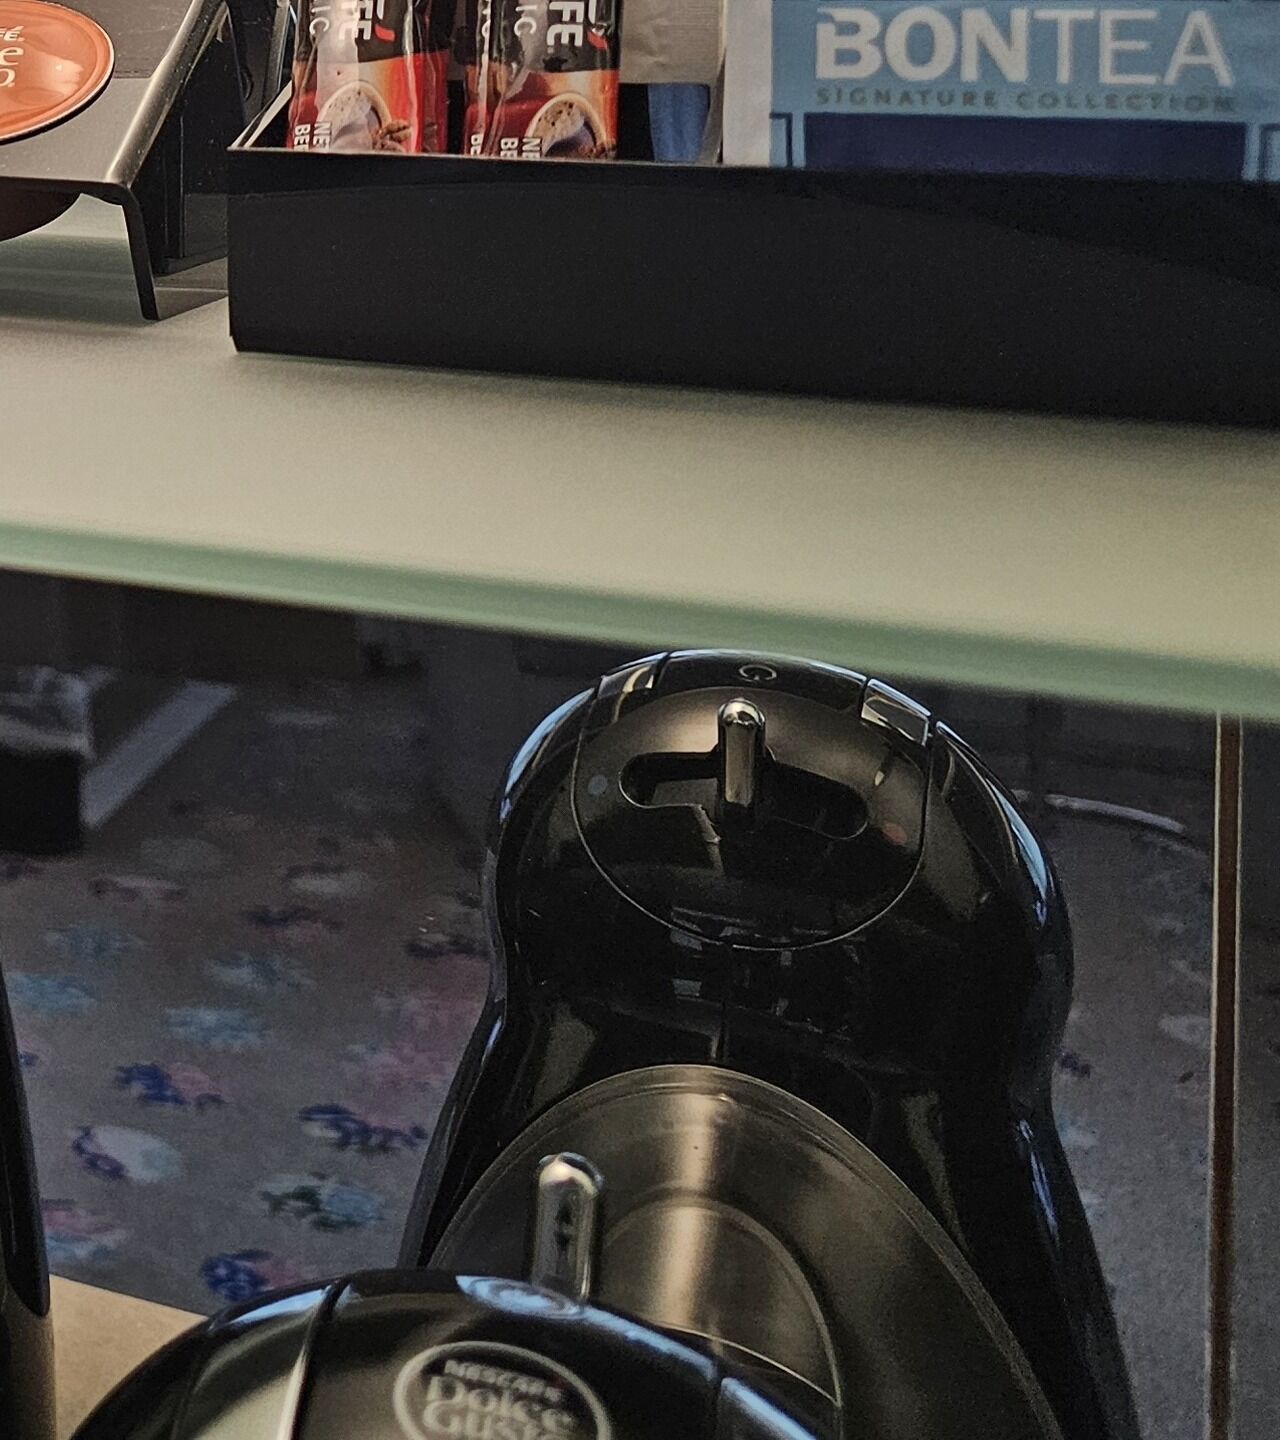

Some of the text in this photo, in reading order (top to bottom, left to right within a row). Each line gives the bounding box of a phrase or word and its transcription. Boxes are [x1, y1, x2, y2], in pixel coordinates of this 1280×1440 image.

[815, 5, 1235, 88] BONTEA
[815, 87, 1238, 115] SIGNATURE COLLECTION
[426, 1376, 575, 1434] Dolce
